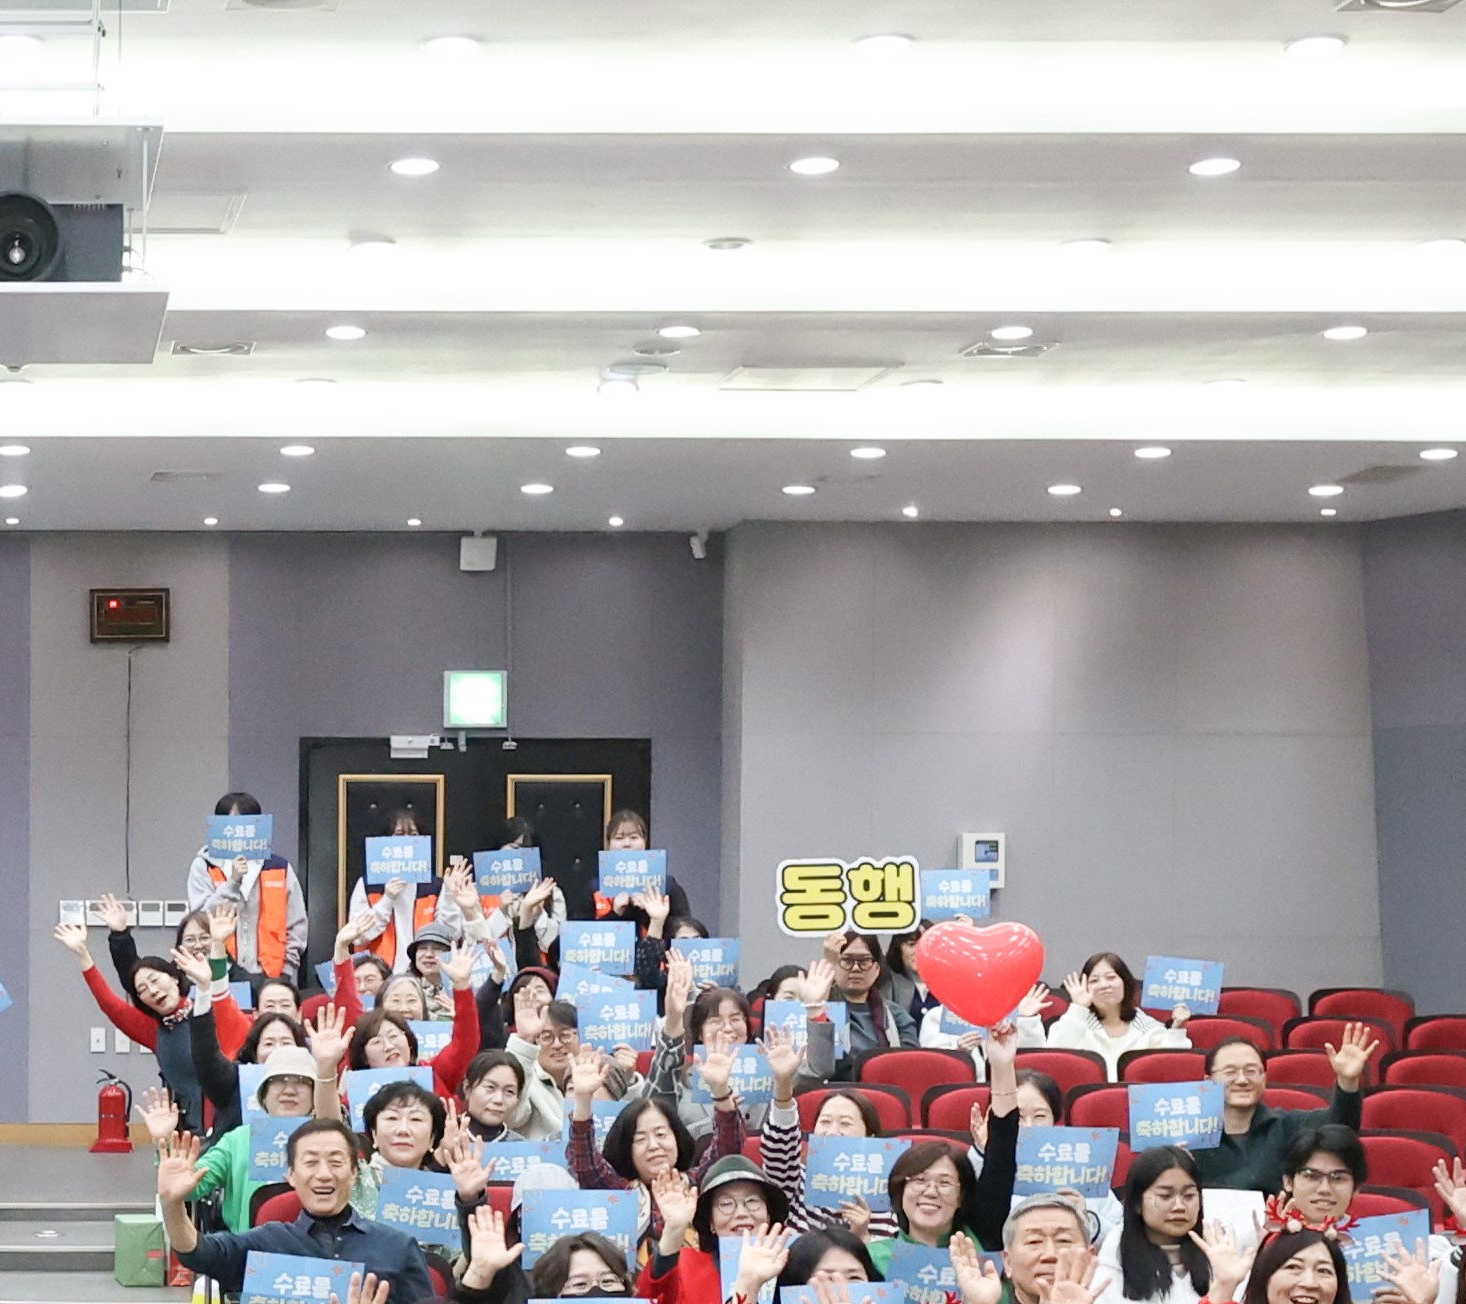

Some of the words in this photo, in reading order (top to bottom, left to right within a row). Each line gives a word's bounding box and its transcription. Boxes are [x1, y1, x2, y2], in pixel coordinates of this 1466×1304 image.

[223, 825, 256, 838] 수료를
[212, 837, 268, 852] 축하합니다!
[382, 846, 413, 860] 수료를
[370, 859, 427, 876] 축하합니다!
[490, 858, 523, 872] 수료를
[616, 860, 648, 874] 수료를
[480, 870, 538, 887] 축하합니다!
[603, 873, 662, 889] 축하합니다!
[938, 879, 973, 893] 수료를
[780, 861, 918, 932] 동행
[926, 893, 985, 908] 축하합니다!
[578, 932, 616, 949] 수료를
[565, 948, 630, 964] 축하합니다!
[688, 948, 723, 962] 수료를
[1164, 968, 1202, 985] 수료를
[1148, 983, 1214, 1003] 축하합니다!
[599, 1004, 640, 1021] 수료를
[784, 1013, 807, 1028] 수료
[584, 1022, 652, 1040] 축하합니다!
[1153, 1096, 1202, 1116] 수료를
[1136, 1115, 1218, 1138] 축하합니다!
[1038, 1141, 1091, 1163] 수료를
[833, 1152, 884, 1175] 수료를
[1018, 1162, 1107, 1185] 축하합니다!
[811, 1174, 888, 1197] 축하합니
[406, 1185, 457, 1207] 수료를
[382, 1204, 461, 1230] 축하합니
[551, 1207, 609, 1230] 수료를
[917, 1264, 956, 1286] 수료
[273, 1272, 331, 1299] 수료를
